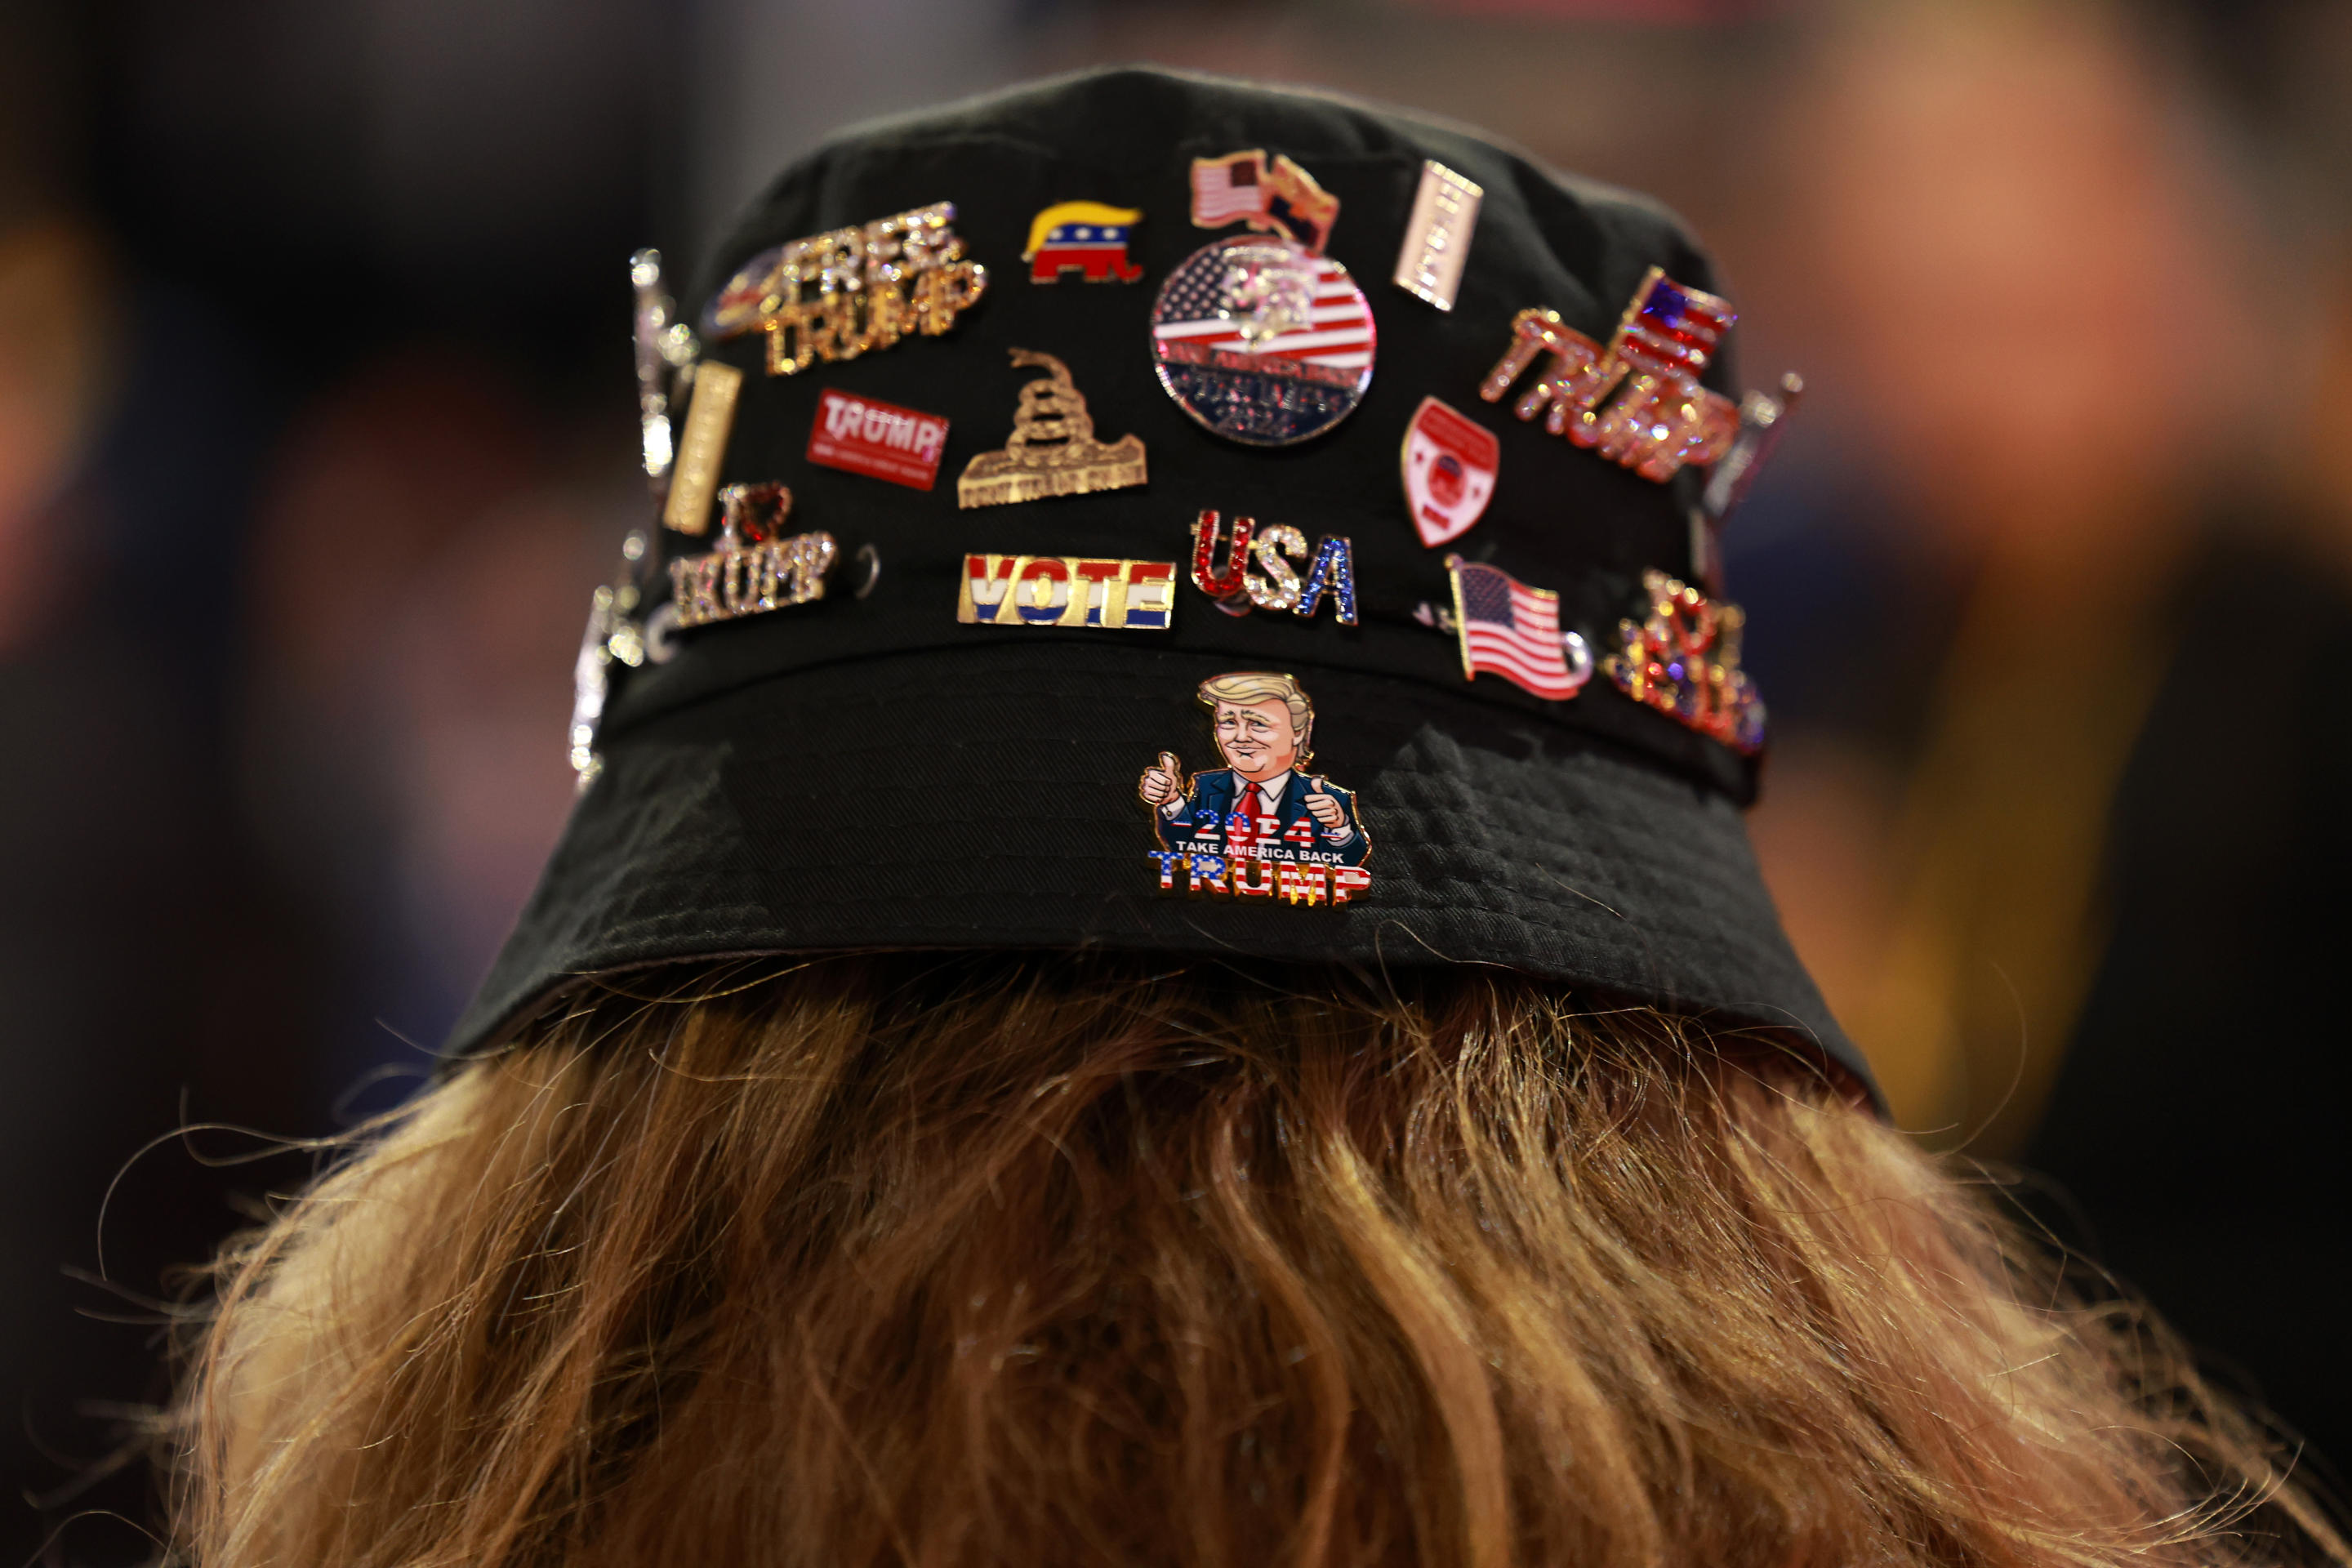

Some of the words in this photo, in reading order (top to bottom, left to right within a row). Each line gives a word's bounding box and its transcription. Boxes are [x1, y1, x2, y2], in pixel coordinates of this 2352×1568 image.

[824, 395, 941, 456] TRUMP
[967, 555, 1176, 628] VOTE
[1191, 510, 1359, 626] USA
[1176, 840, 1219, 855] TAKE
[1223, 844, 1296, 861] AMERICA
[1299, 850, 1345, 865] BACK
[1195, 809, 1316, 849] 2024
[1147, 850, 1372, 903] TRUMP
